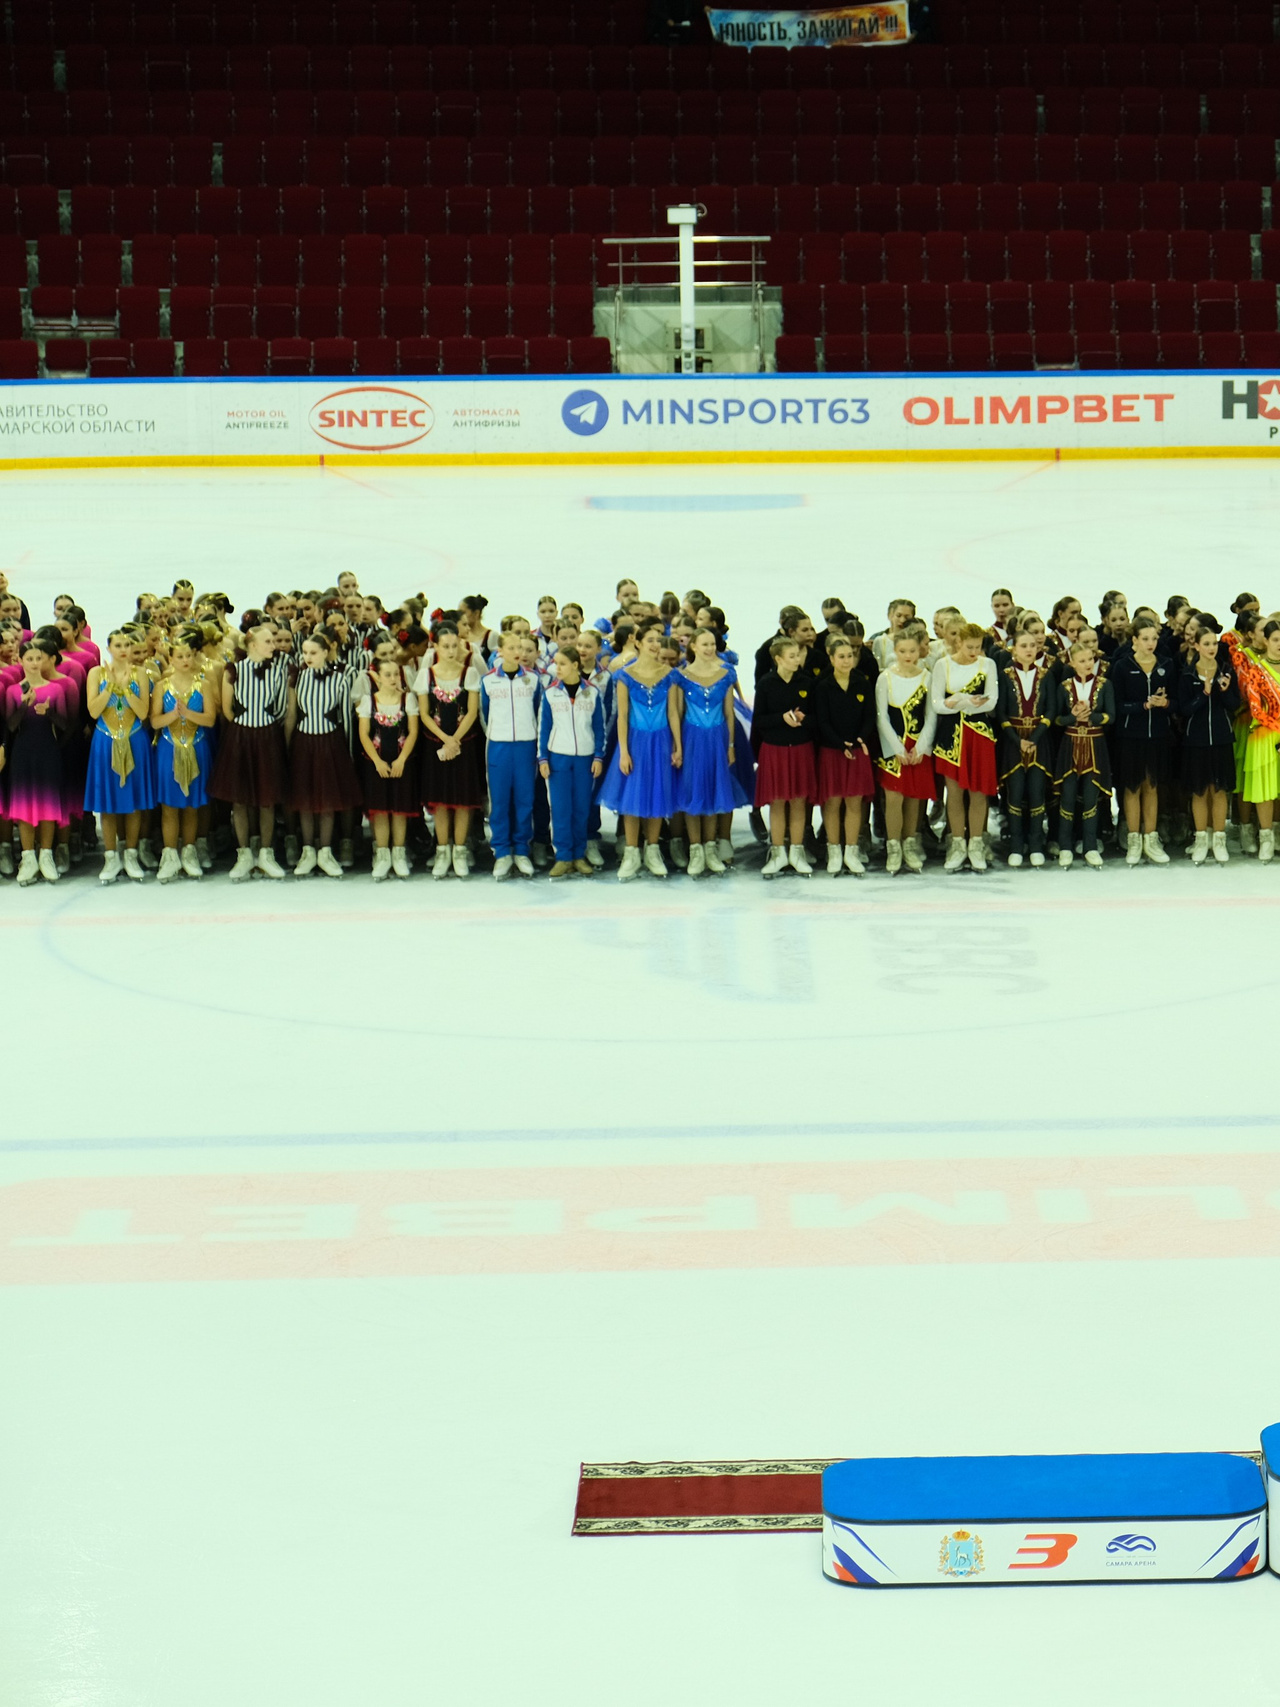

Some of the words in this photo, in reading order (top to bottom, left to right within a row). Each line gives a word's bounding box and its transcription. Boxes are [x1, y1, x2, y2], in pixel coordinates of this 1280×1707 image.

[719, 20, 792, 43] ЮНОСТЬ,
[796, 13, 880, 40] ЗАЖИГАЙ
[227, 410, 266, 418] MOTOR
[269, 410, 286, 418] OIL
[452, 408, 520, 417] АВТОМАСЛА
[621, 398, 870, 425] MINSPORT63
[902, 394, 1175, 426] OLIMPBET
[80, 420, 155, 433] ОБЛАСТИ
[225, 421, 289, 430] ANTIFREEZE
[318, 409, 426, 428] SINTEC
[452, 419, 520, 428] АНТИФРИЗЫ
[1008, 1533, 1078, 1569] 3
